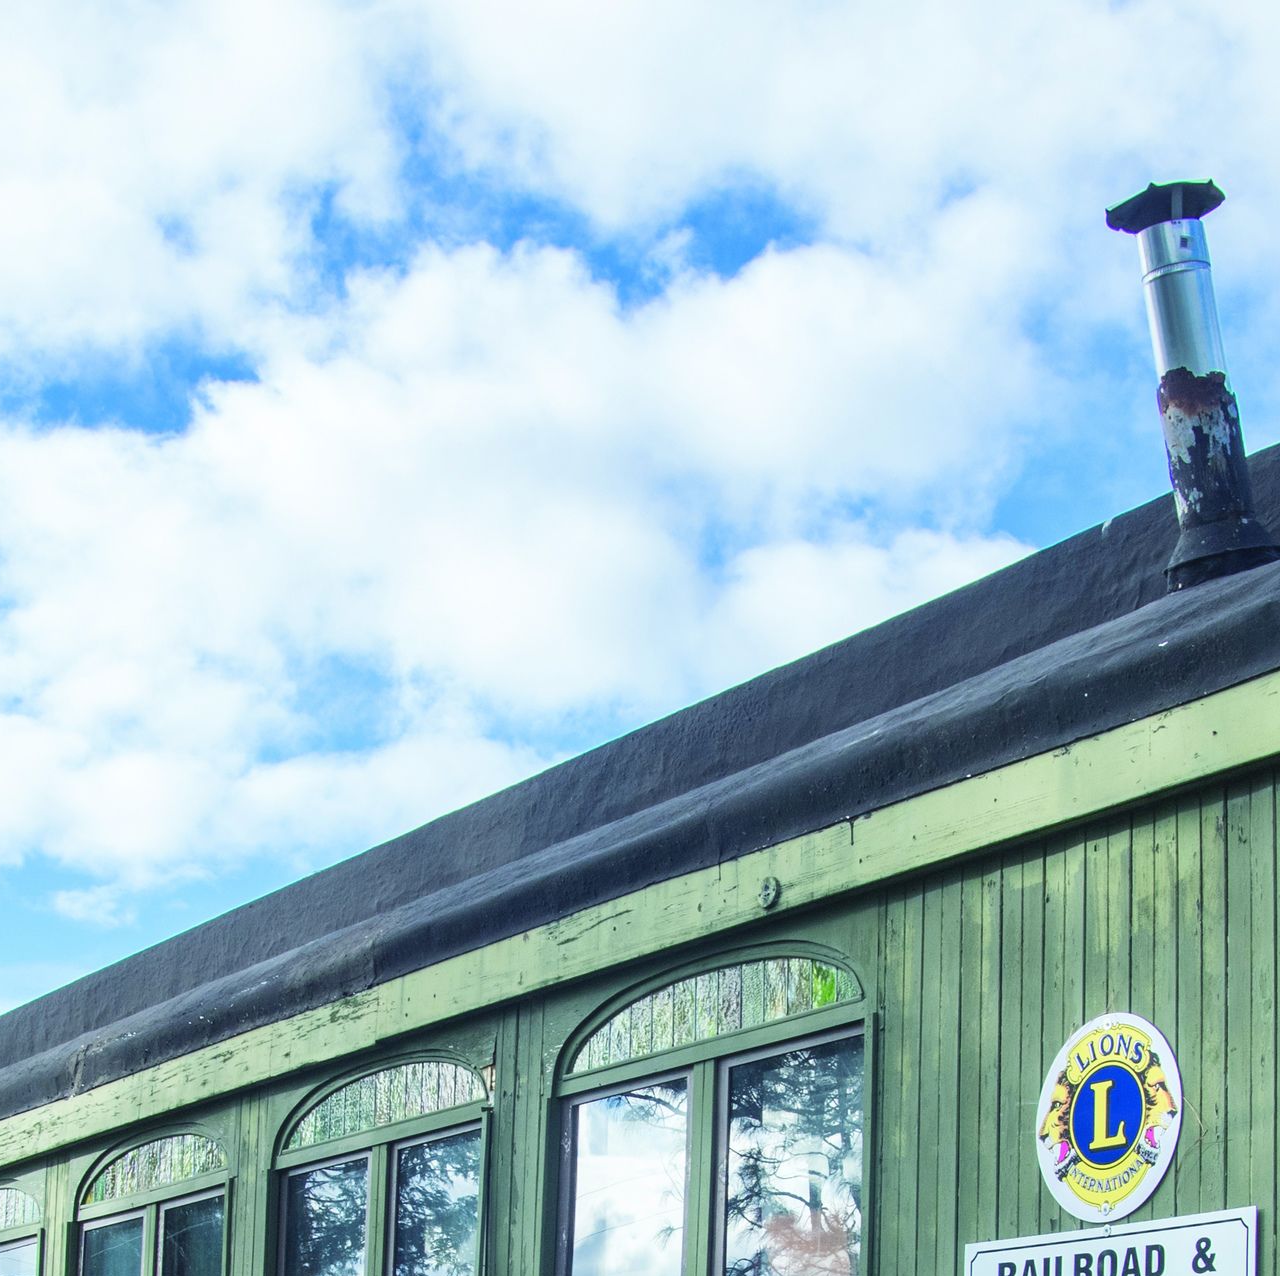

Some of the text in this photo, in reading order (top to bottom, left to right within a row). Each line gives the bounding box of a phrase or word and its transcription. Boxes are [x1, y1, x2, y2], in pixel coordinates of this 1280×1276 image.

[1073, 1033, 1145, 1073] LIONS
[1089, 1080, 1127, 1151] L
[1191, 1237, 1216, 1275] &
